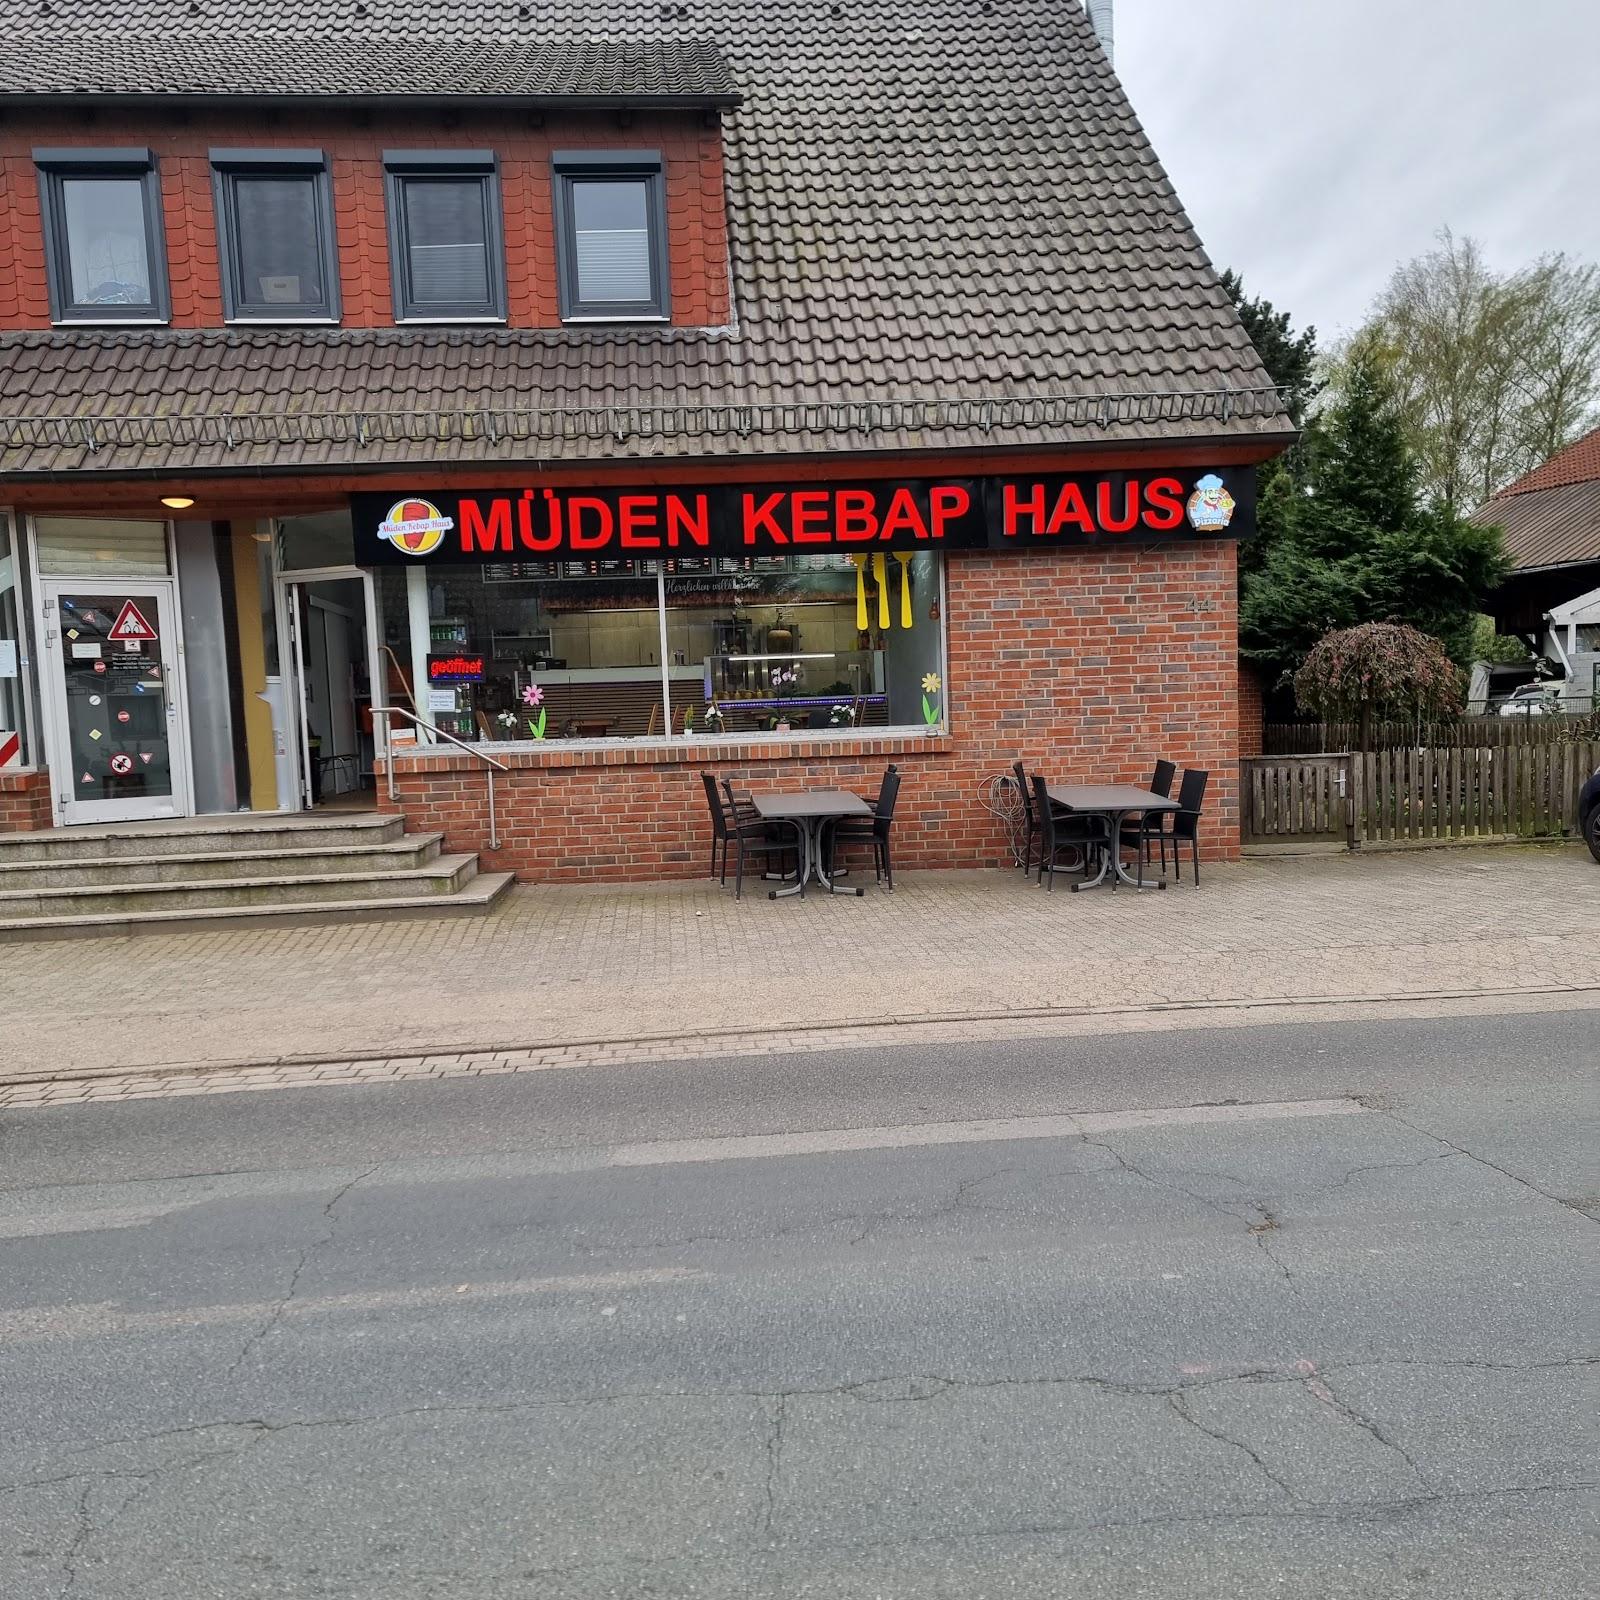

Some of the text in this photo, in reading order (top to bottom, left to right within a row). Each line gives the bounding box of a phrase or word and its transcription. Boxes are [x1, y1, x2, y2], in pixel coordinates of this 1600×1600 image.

[458, 478, 1184, 552] MÜDEN KEBAP HAUS
[1187, 593, 1212, 613] 44
[430, 658, 482, 677] geöffnet
